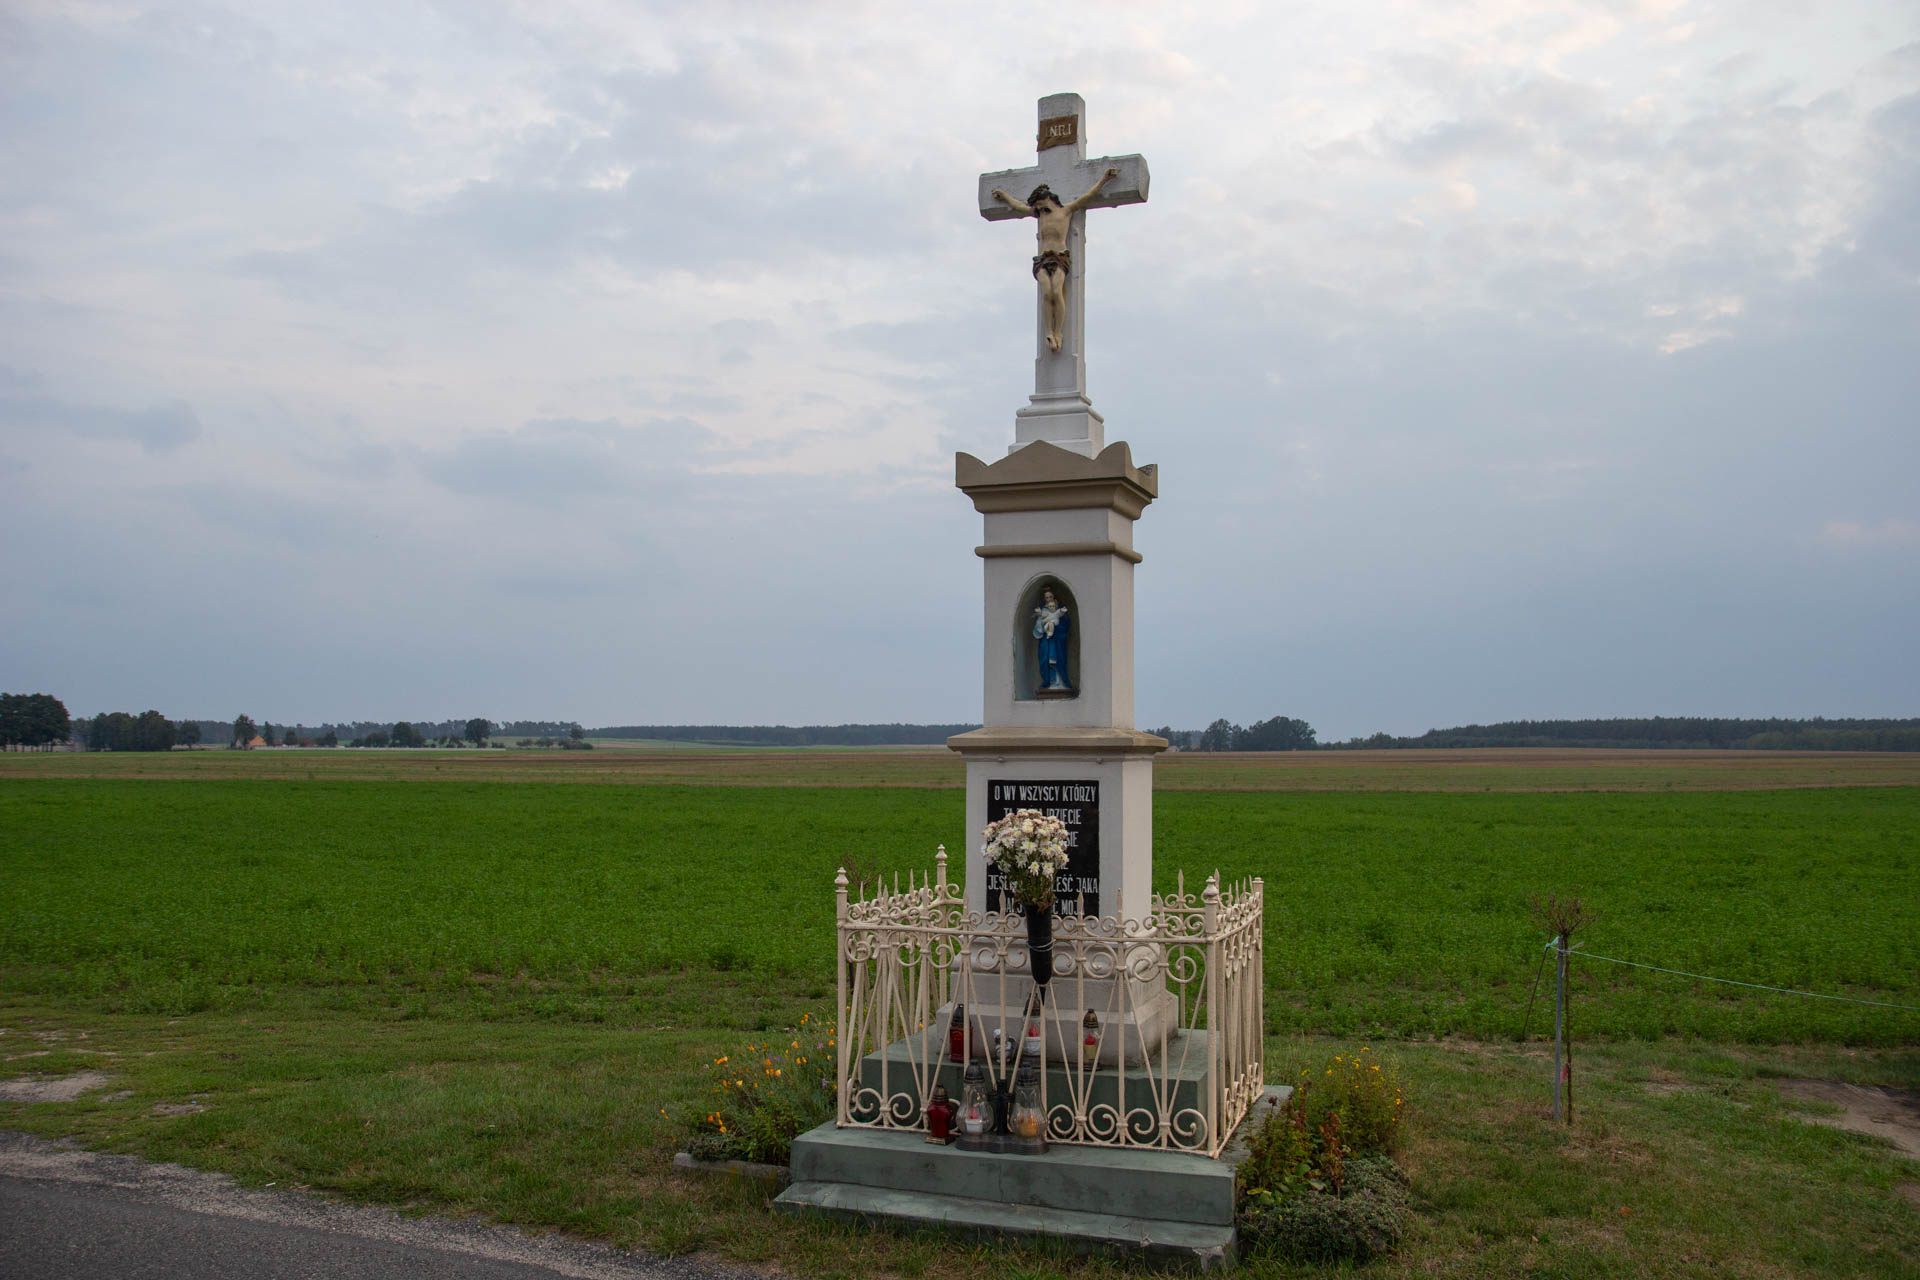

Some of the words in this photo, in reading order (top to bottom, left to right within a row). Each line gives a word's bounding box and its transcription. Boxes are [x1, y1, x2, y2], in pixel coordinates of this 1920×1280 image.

[1045, 124, 1072, 136] INRI
[994, 786, 1000, 800] O
[1003, 786, 1016, 801] WY
[1019, 785, 1060, 802] WSZYSCY
[1063, 783, 1096, 802] KTÓRZY
[1076, 877, 1098, 893] JAKA
[1061, 899, 1084, 915] MOJ
